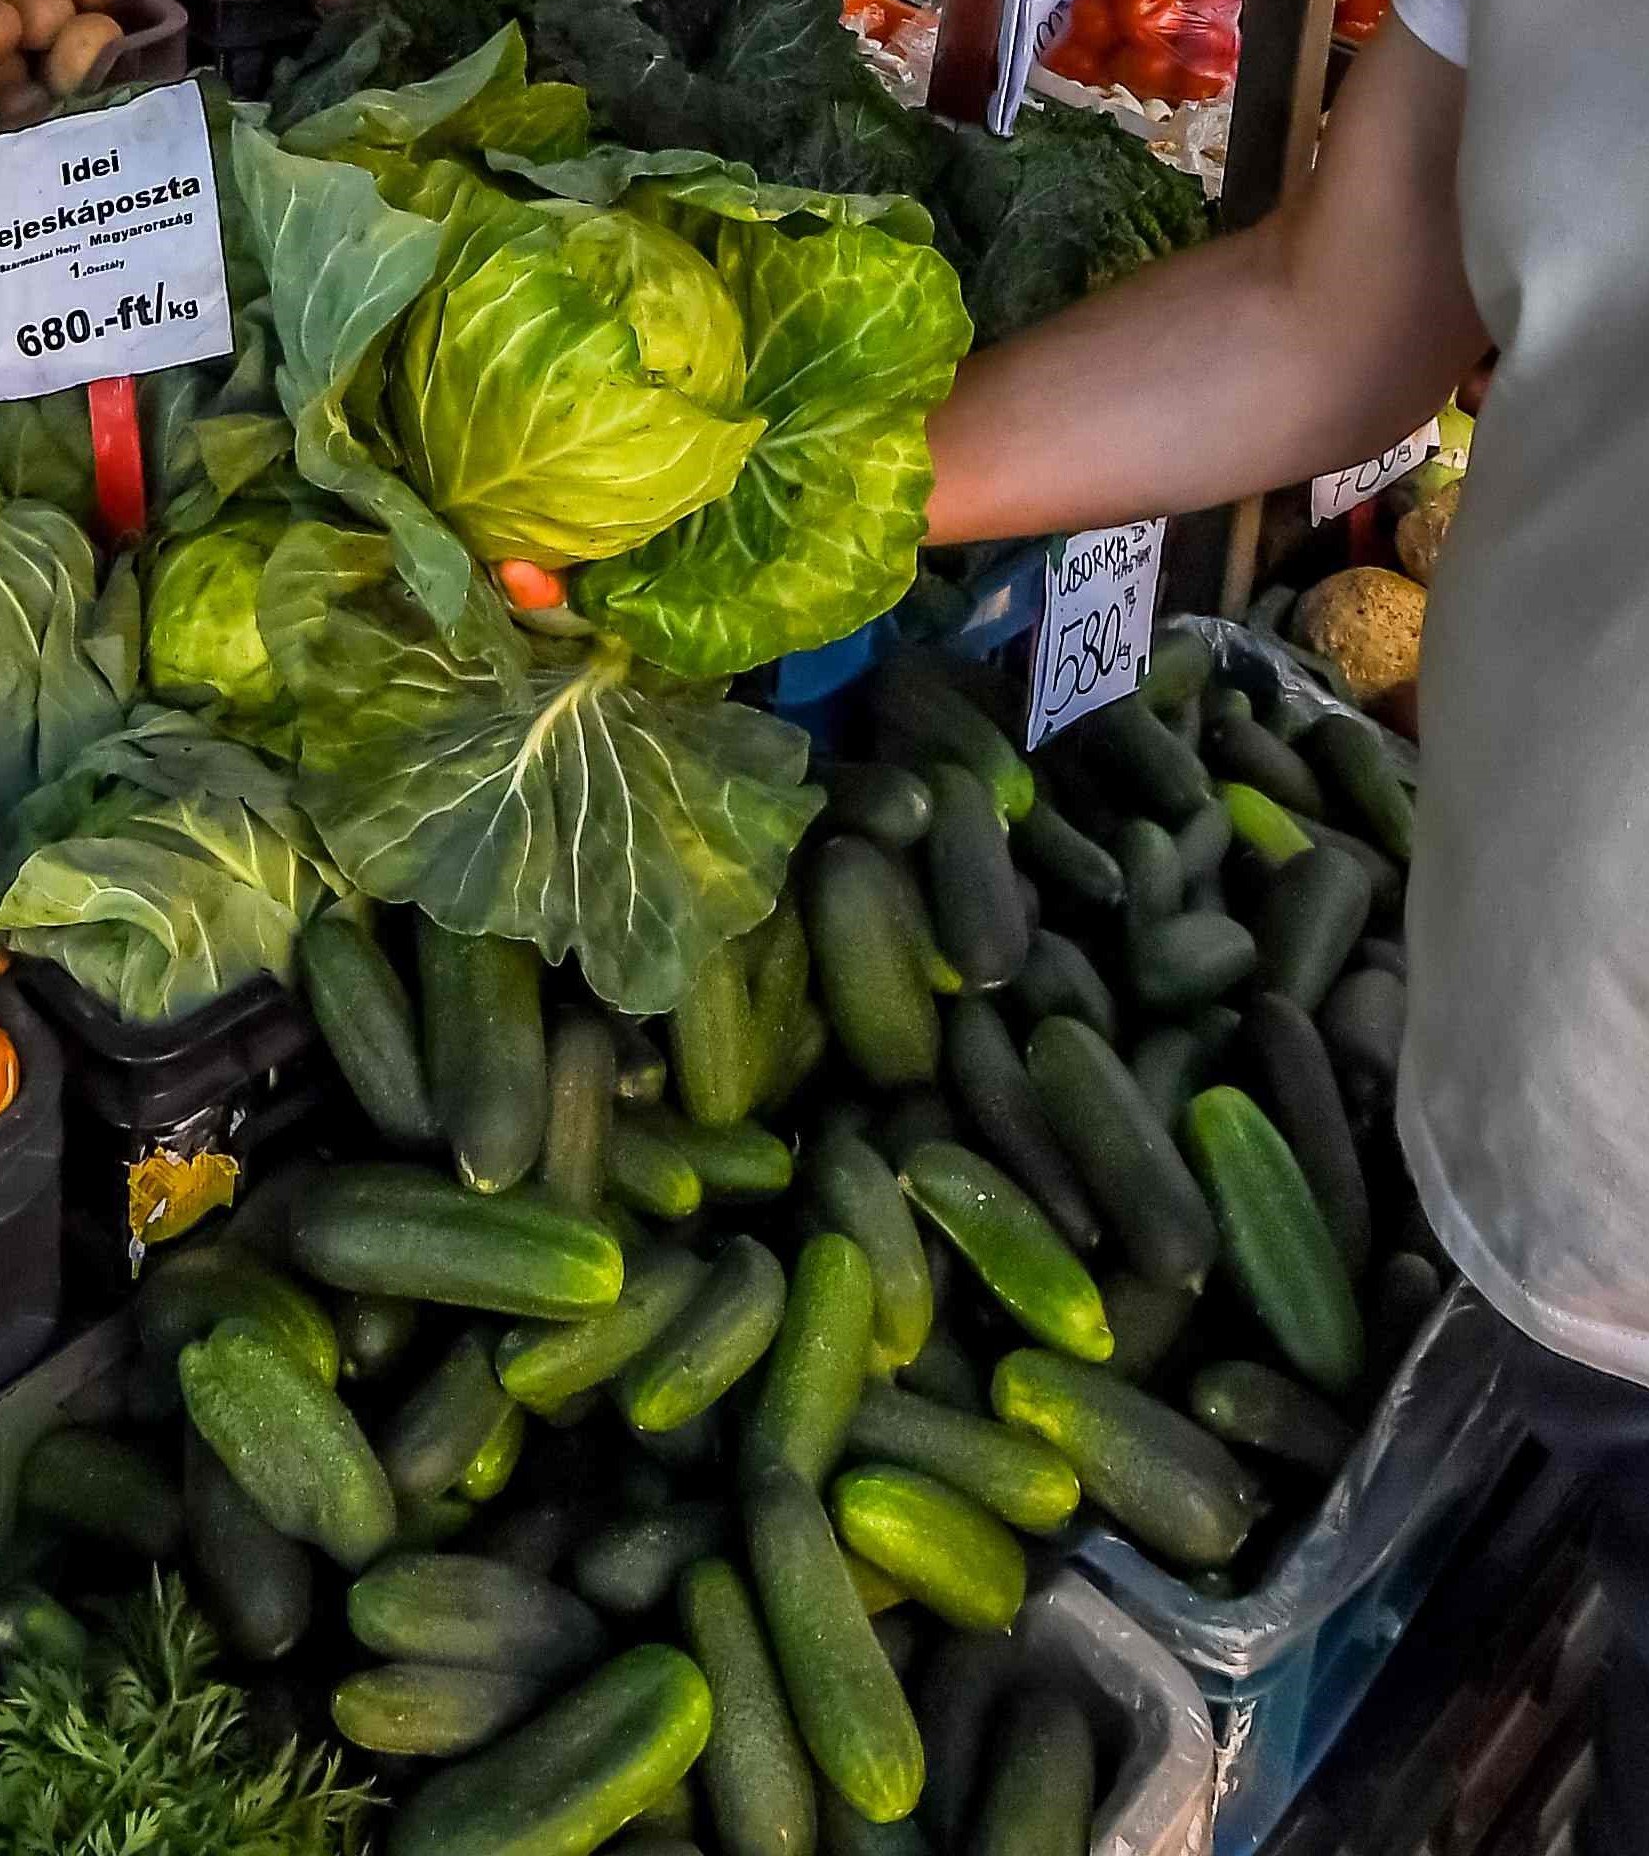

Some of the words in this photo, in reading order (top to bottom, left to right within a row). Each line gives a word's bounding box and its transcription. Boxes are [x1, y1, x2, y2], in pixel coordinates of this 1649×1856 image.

[61, 149, 120, 185] Idei
[89, 212, 194, 246] Magyarország
[1058, 535, 1128, 597] UBORKA
[1045, 603, 1121, 716] 580
